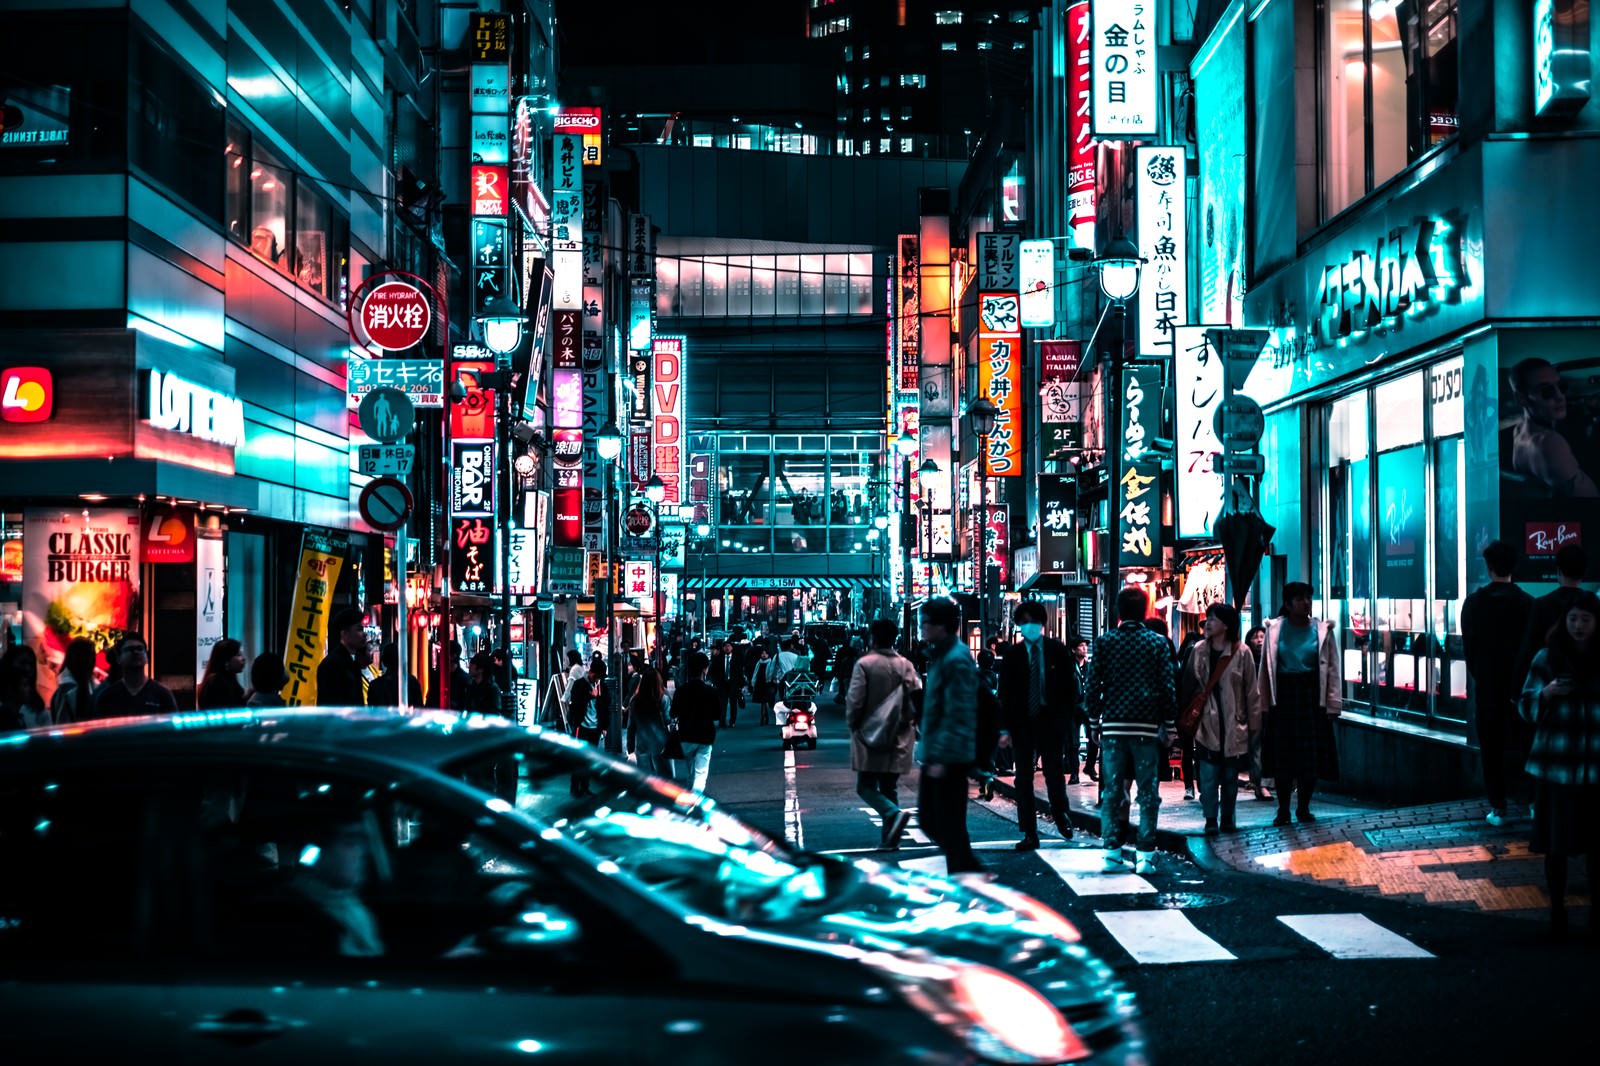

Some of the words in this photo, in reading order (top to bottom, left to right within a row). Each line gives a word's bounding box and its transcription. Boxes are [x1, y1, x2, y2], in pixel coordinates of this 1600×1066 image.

[1103, 23, 1130, 104] 金の目
[554, 116, 571, 128] BIG
[571, 116, 600, 127] ECHO
[1068, 170, 1084, 188] BIG
[1002, 235, 1014, 290] ブルマン
[373, 292, 386, 300] FIRE
[389, 292, 417, 300] HYDRANT
[369, 303, 424, 329] 消火栓
[561, 312, 574, 360] バラの木
[1430, 367, 1464, 405] コンタク
[1053, 429, 1071, 440] 2F
[555, 440, 582, 455] 楽園
[365, 460, 376, 472] 12
[397, 460, 409, 471] 17
[462, 451, 483, 505] BAR
[483, 501, 491, 512] 2F
[48, 532, 131, 555] CLASSIC
[48, 561, 131, 582] BURGER
[1053, 560, 1065, 569] B1
[459, 581, 486, 591] 春日亭
[769, 579, 796, 587] 3.15M
